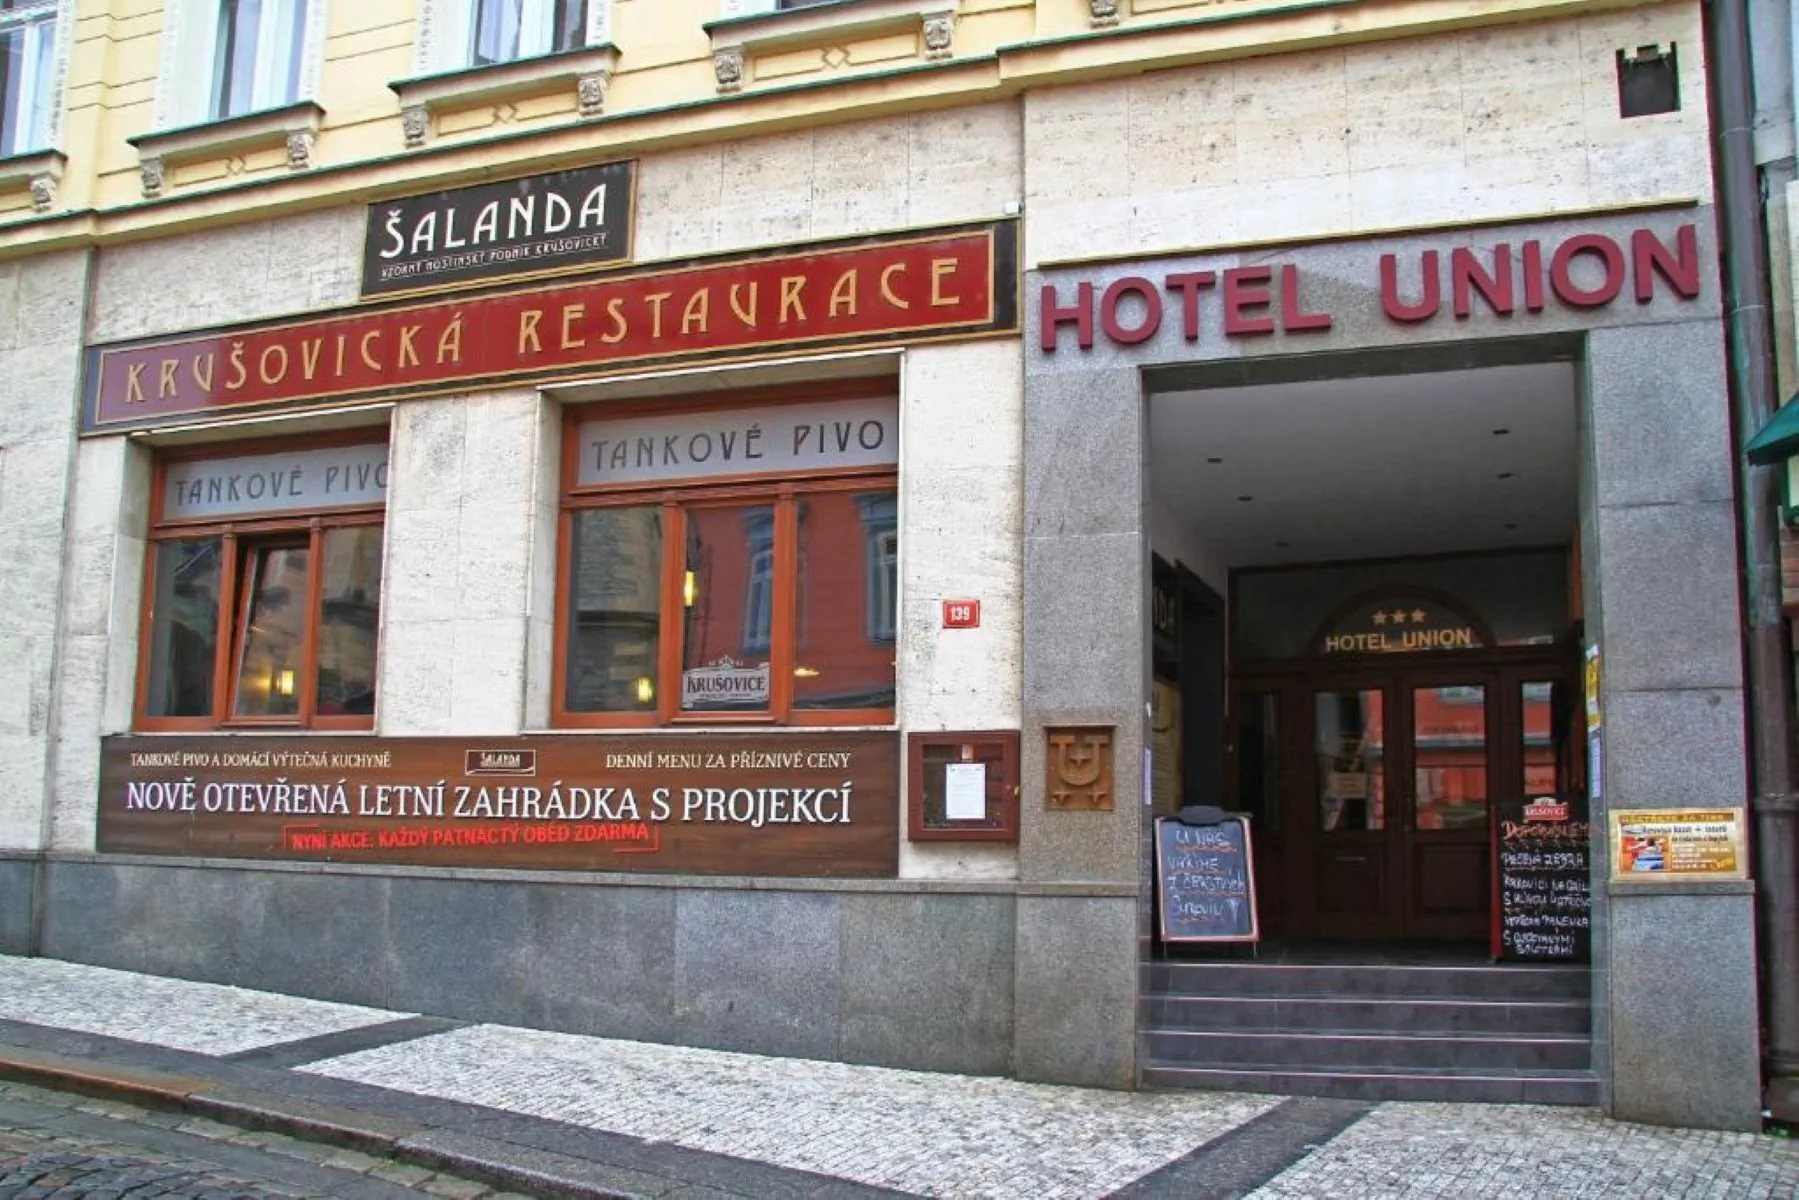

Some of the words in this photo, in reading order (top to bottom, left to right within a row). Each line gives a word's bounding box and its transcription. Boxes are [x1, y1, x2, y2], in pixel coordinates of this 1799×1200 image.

[379, 183, 607, 259] ŠALANDA
[1040, 263, 1334, 351] HOTEL
[1380, 223, 1700, 323] UNION
[125, 311, 464, 403] KRUŠOVICKÁ
[518, 257, 960, 354] RESTAURACE
[591, 424, 763, 471] TANKOVÉ
[793, 420, 885, 457] PIVO
[175, 465, 304, 506] TANKOVÉ
[950, 606, 971, 622] 139
[1325, 633, 1392, 652] HOTEL
[1402, 627, 1471, 648] UNION
[686, 673, 765, 693] KRUŠOVICE
[130, 751, 181, 767] TANKOVÉ
[183, 753, 209, 767] PIVO
[211, 753, 220, 767] A
[223, 751, 270, 767] DOMÁCÍ
[272, 751, 328, 768] VÝTEČNÁ
[332, 751, 392, 768] KUCHYNĚ
[606, 751, 652, 768] DENNÍ
[657, 753, 701, 768] MENU
[705, 753, 725, 768] ZA
[731, 751, 804, 768] PŘÍZNIVÉ
[807, 752, 852, 769] CENY
[126, 777, 197, 811] NOVĚ
[203, 777, 351, 815] OTEVŘENÁ
[358, 779, 446, 817] LETNÍ
[453, 780, 641, 820] ZAHRÁDKA
[651, 787, 671, 820] S
[681, 780, 853, 828] PROJEKCÍ
[379, 825, 429, 848] KAŽDÝ
[573, 822, 649, 842] ZDARMA
